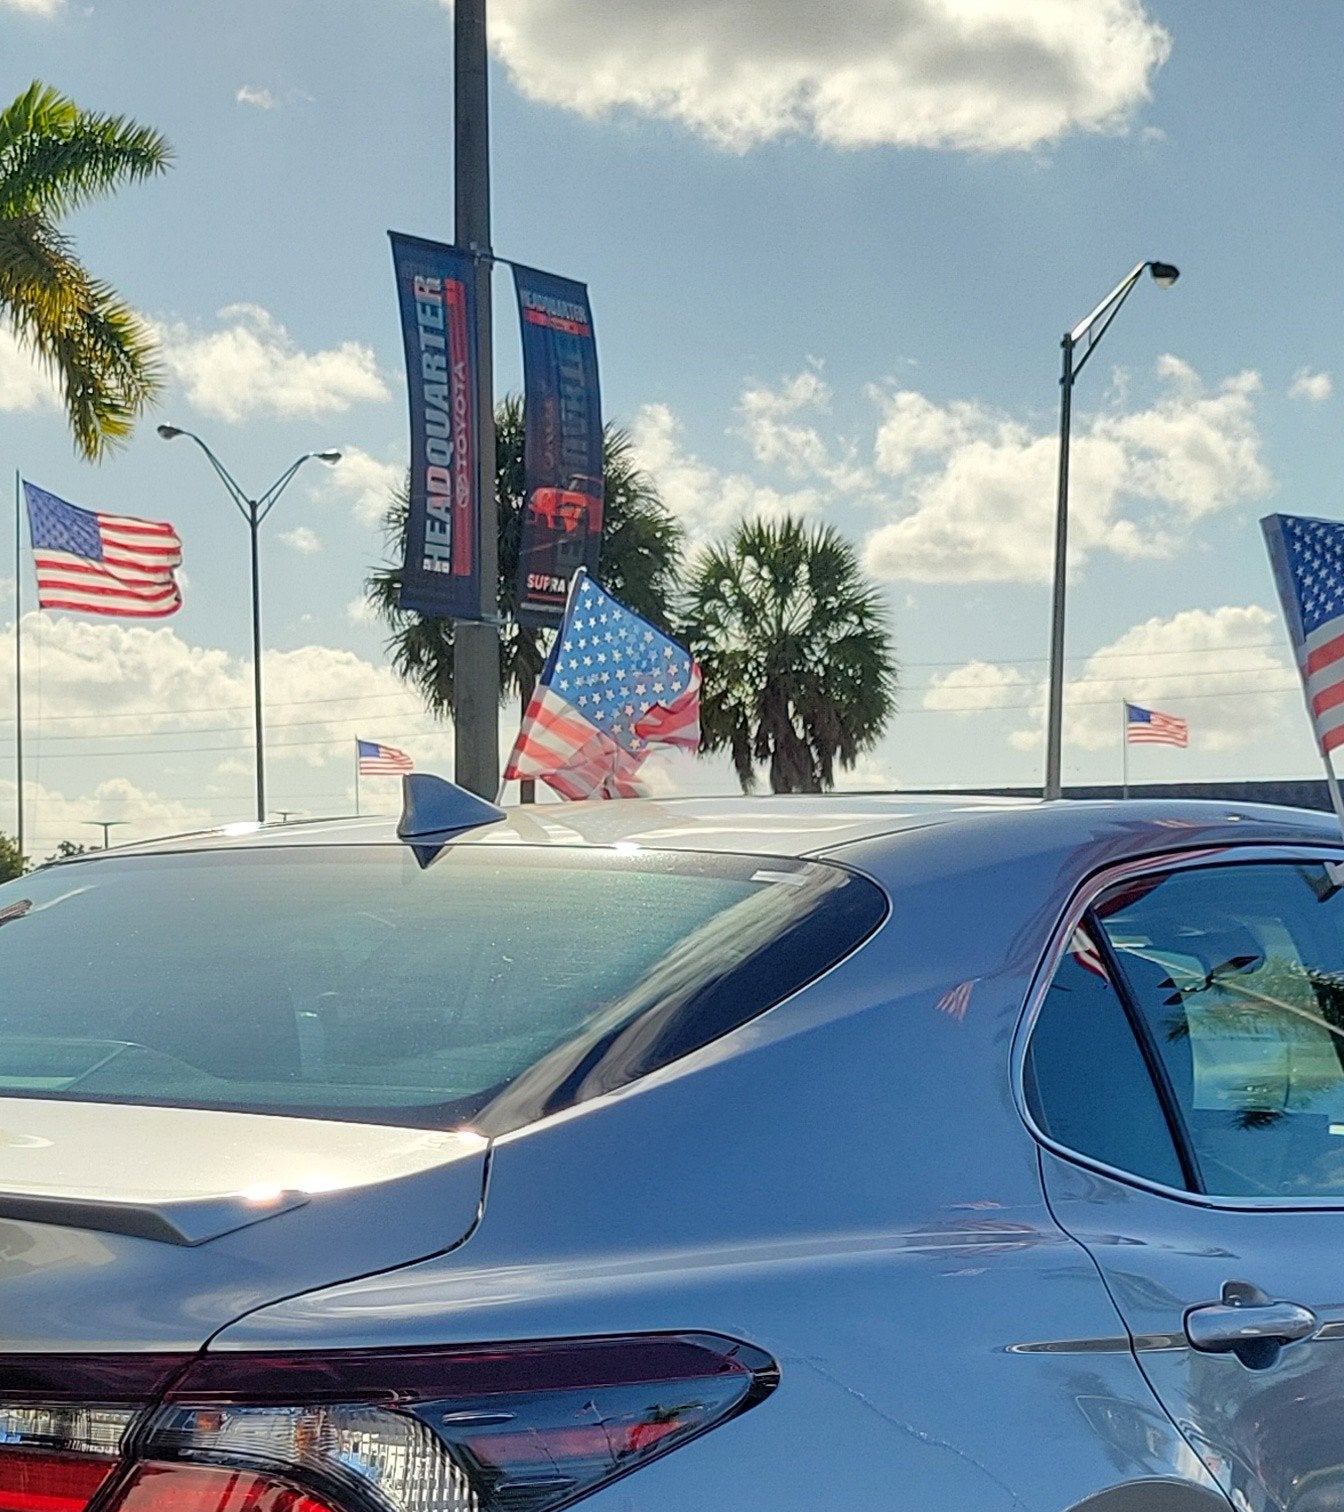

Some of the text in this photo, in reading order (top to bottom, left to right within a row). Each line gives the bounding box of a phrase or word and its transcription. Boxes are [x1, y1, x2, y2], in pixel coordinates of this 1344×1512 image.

[414, 274, 452, 575] HEADQUARTER
[452, 361, 468, 468] TOYOTA
[527, 573, 566, 593] SUPRA
